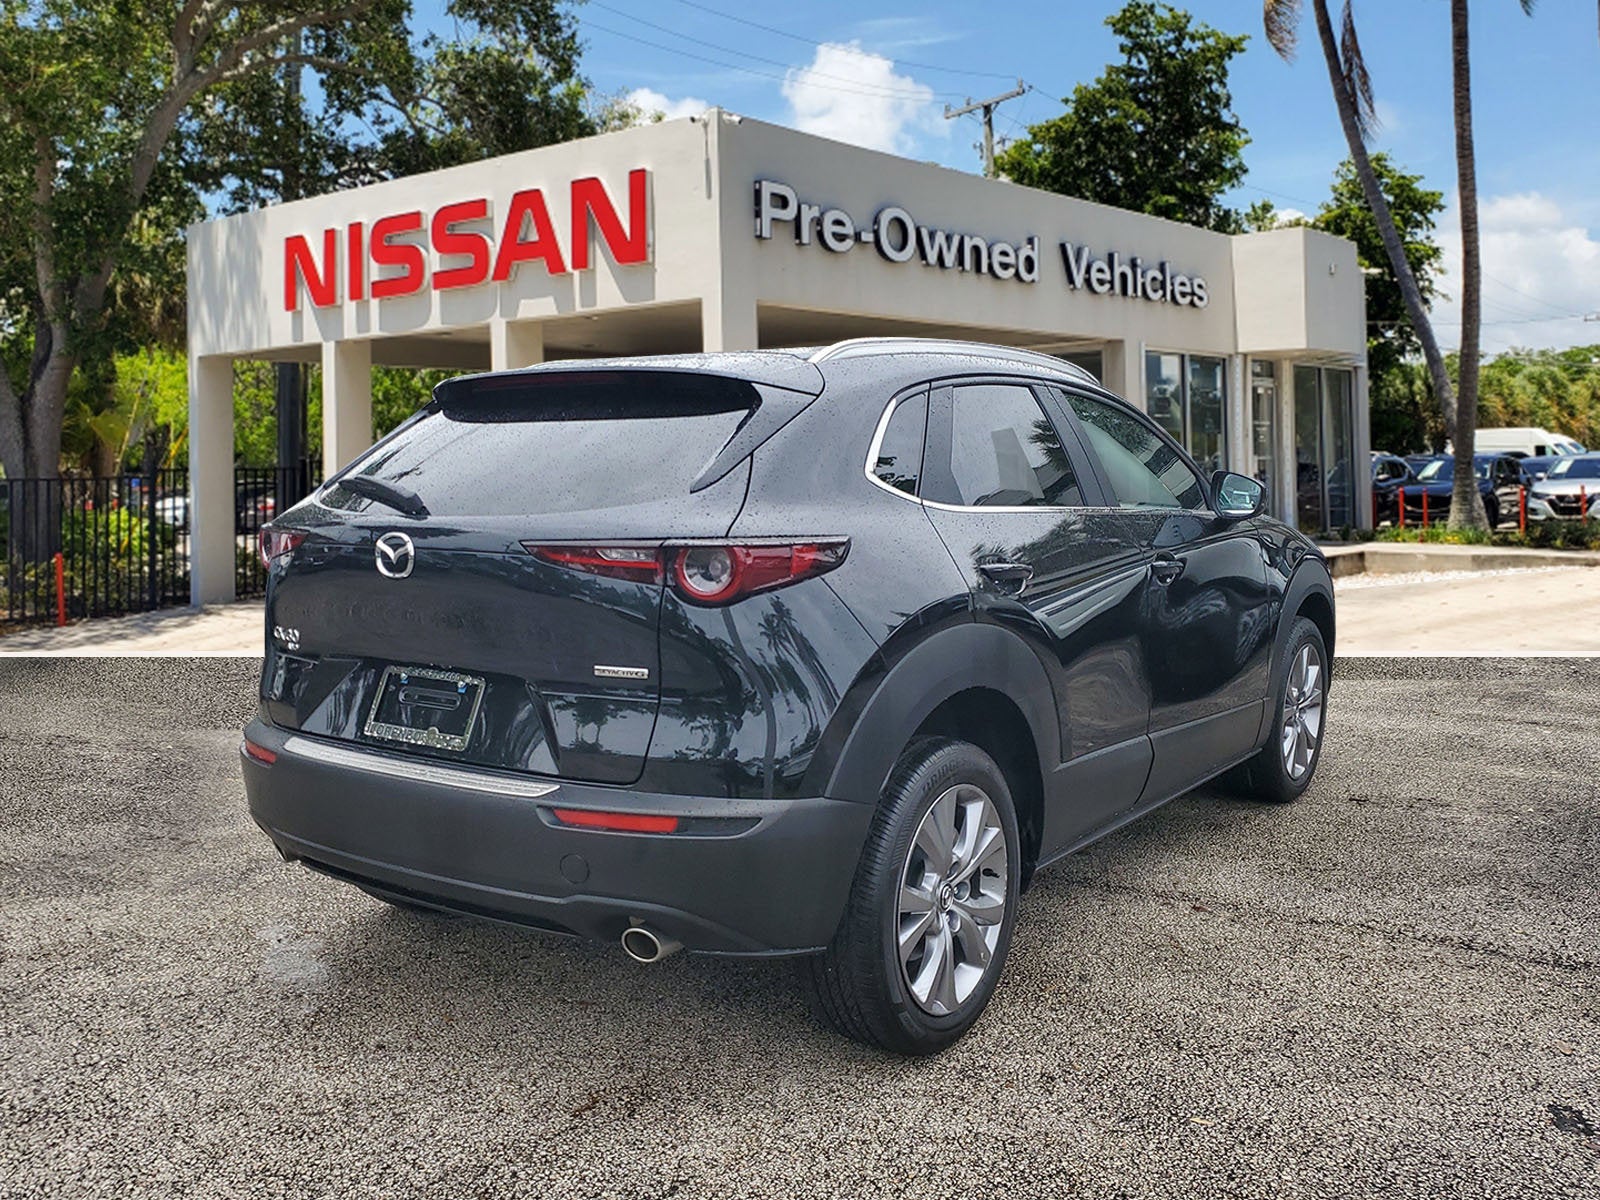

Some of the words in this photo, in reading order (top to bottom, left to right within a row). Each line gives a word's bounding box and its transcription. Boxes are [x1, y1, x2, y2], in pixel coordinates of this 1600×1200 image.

[285, 168, 647, 312] NISSAN
[754, 179, 1039, 283] Pre-Owned
[1059, 242, 1208, 308] Vehicles
